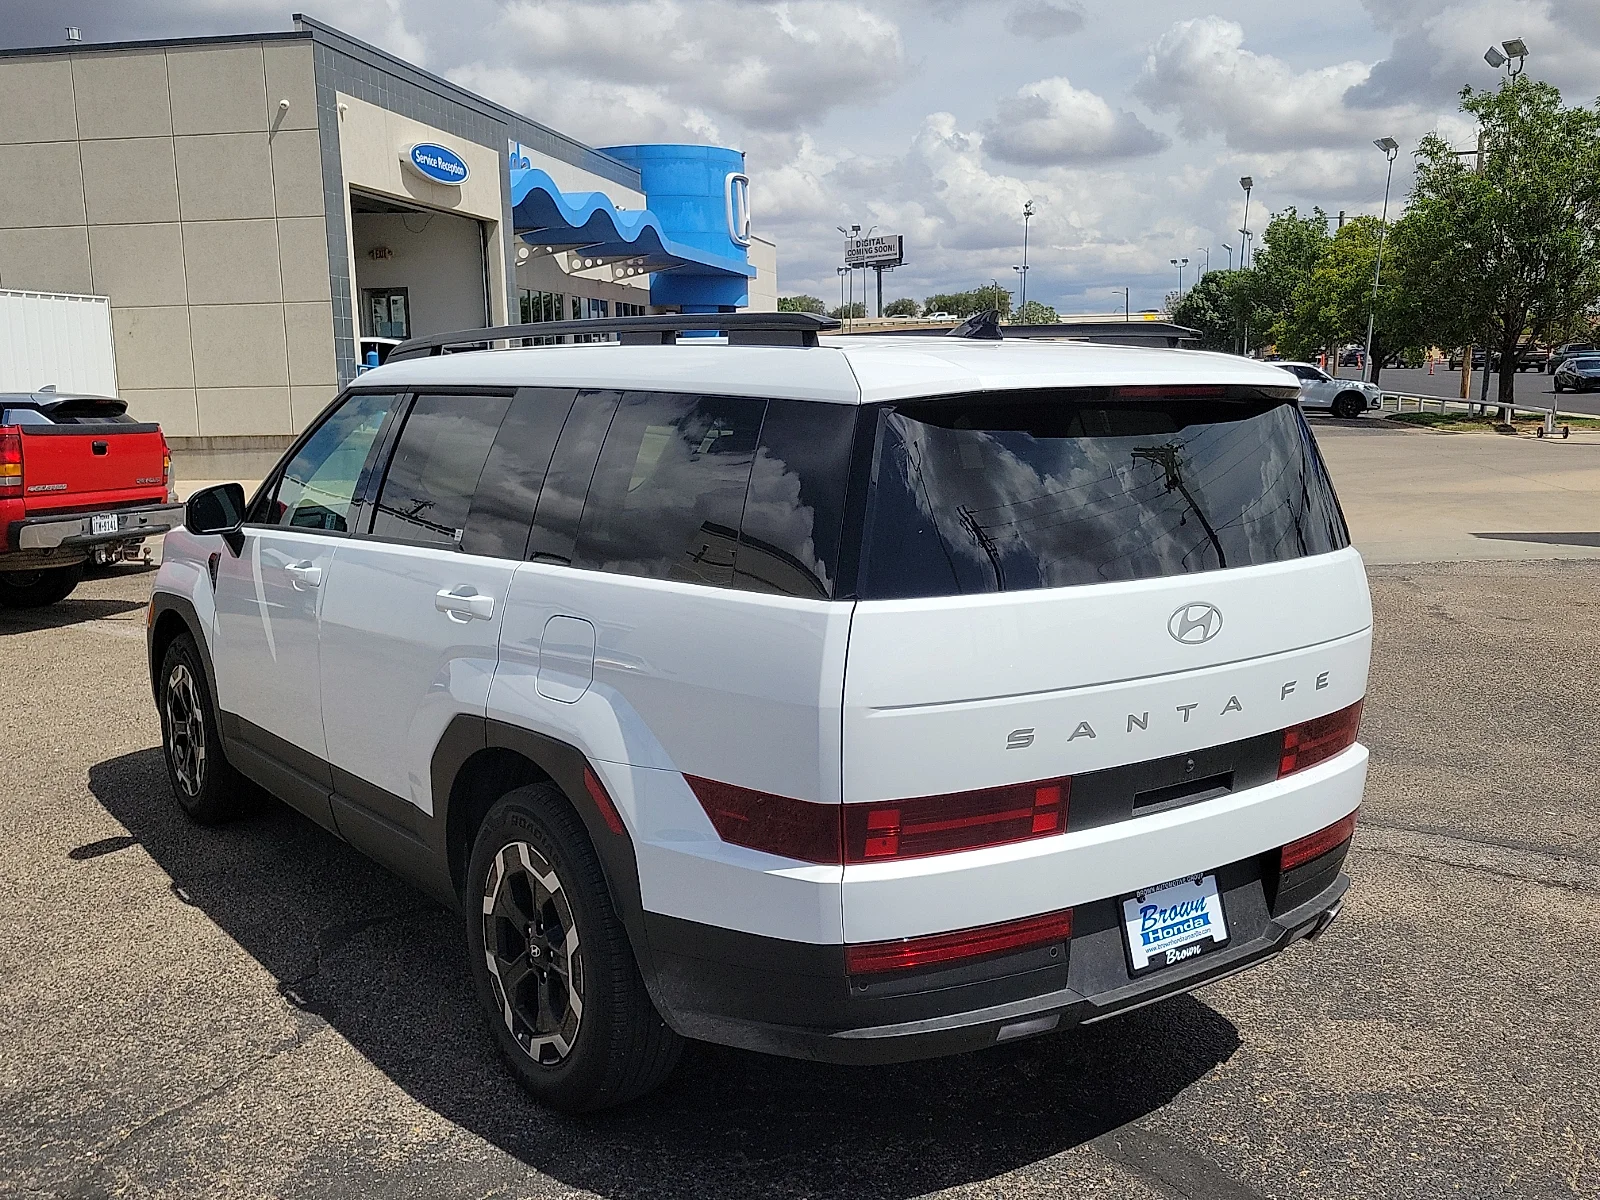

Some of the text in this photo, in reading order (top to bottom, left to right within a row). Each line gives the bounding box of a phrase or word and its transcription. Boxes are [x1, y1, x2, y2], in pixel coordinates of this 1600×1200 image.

[415, 150, 465, 176] Service Reception
[847, 244, 895, 256] COMING SOON!
[856, 238, 886, 248] DIGITAL
[1005, 671, 1330, 750] SANTA FE
[1140, 896, 1207, 931] Brown
[1148, 918, 1205, 943] Honda
[1165, 944, 1201, 965] Brown
